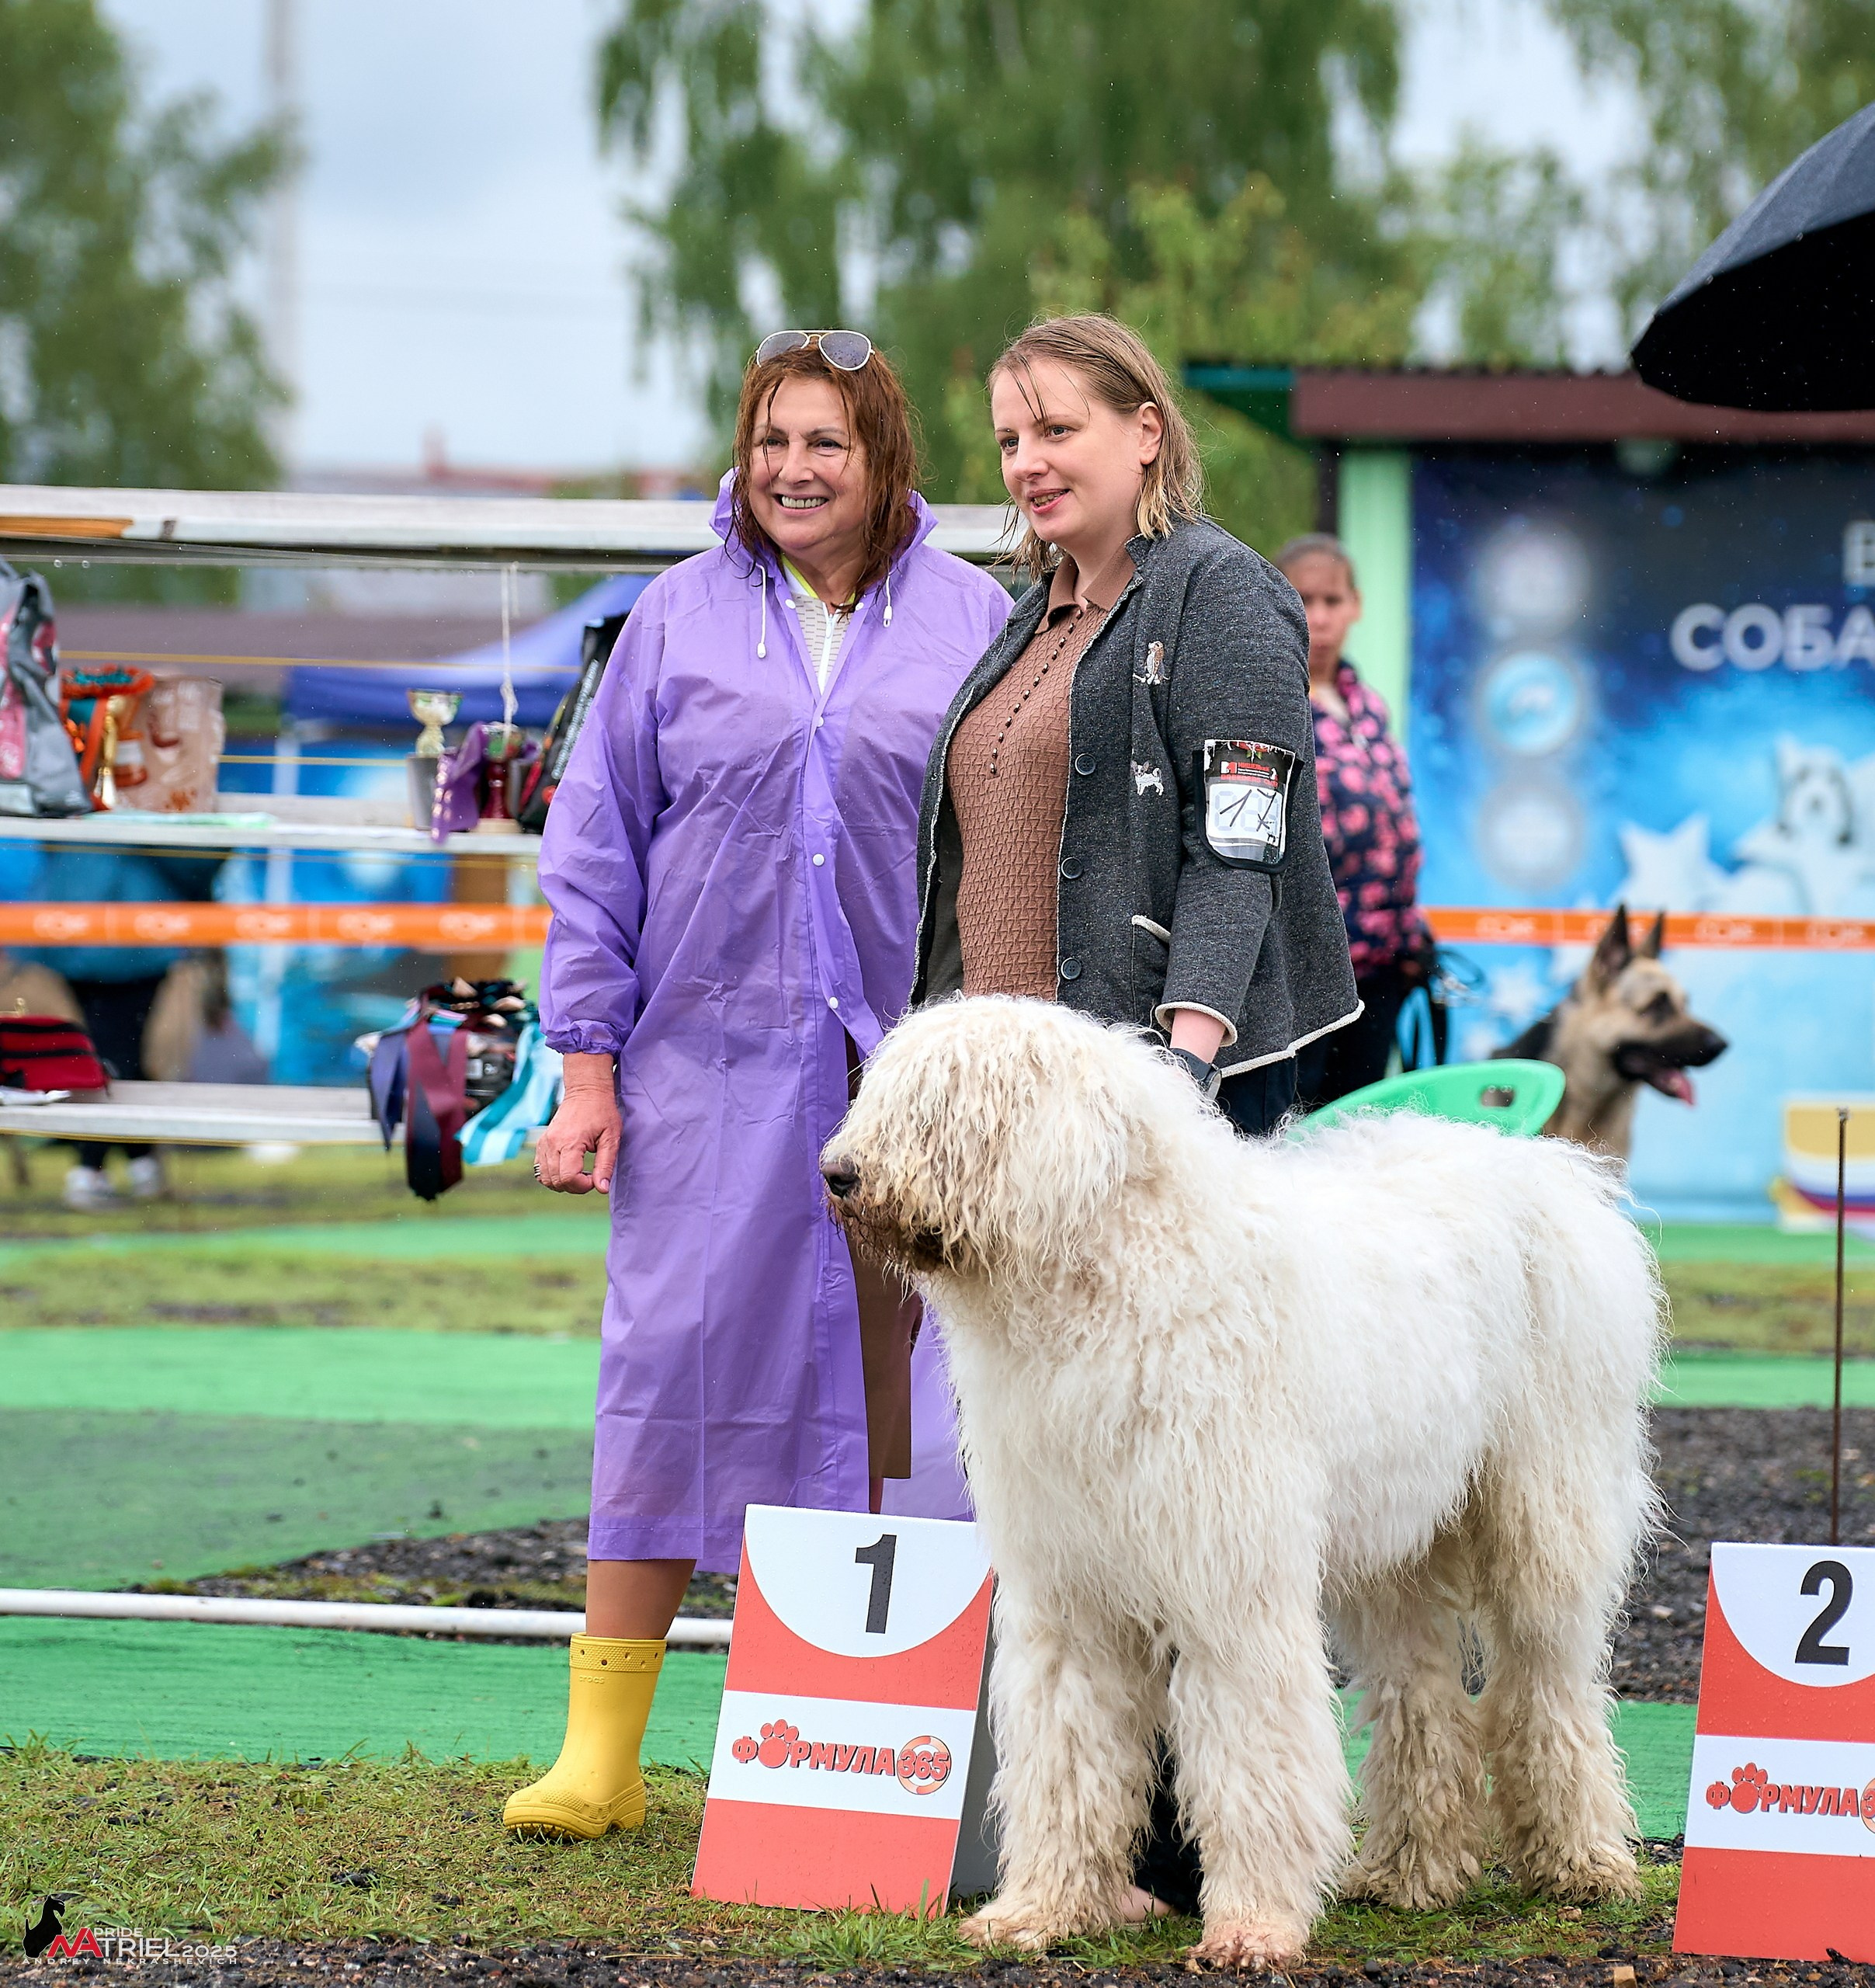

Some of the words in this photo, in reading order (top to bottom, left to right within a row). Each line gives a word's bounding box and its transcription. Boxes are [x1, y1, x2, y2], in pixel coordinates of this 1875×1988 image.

[855, 1534, 897, 1634] 1
[1794, 1560, 1853, 1666] 2
[578, 1675, 606, 1684] crocs
